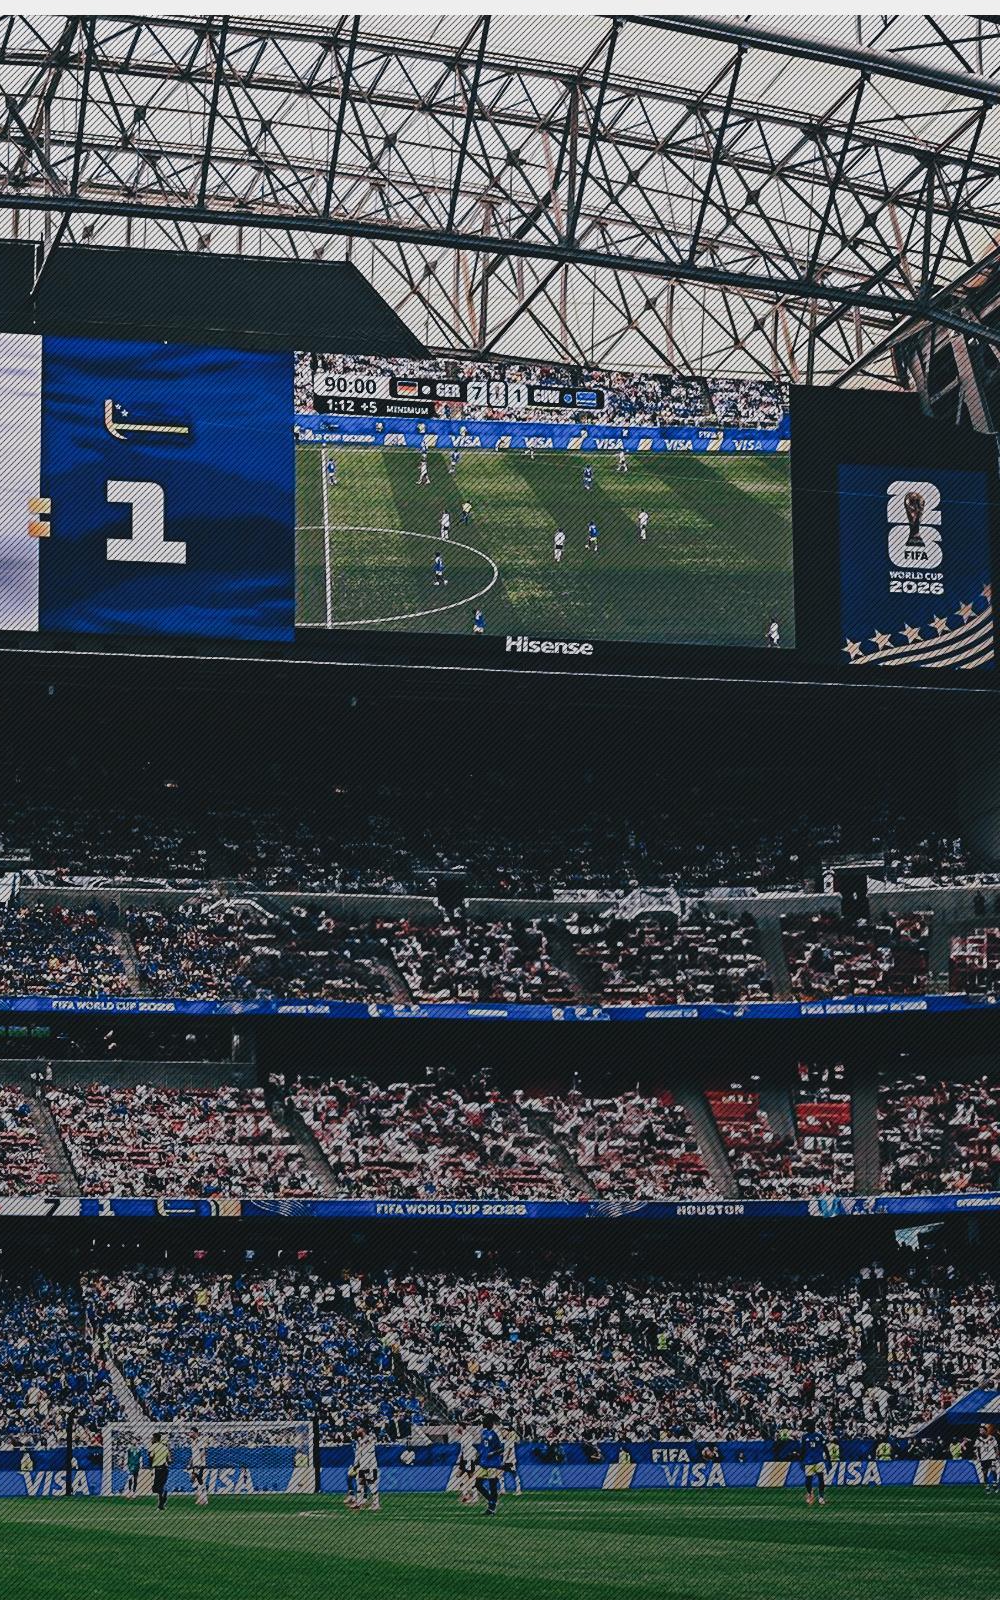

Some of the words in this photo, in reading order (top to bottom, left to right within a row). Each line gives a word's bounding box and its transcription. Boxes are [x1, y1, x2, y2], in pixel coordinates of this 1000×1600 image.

[324, 376, 378, 395] 90:00
[436, 382, 461, 398] GER
[471, 386, 483, 401] 7
[513, 389, 522, 403] 1
[533, 388, 560, 404] CUW
[326, 399, 355, 413] 1:12
[360, 400, 378, 414] +5
[386, 405, 429, 415] MINIMUM
[450, 435, 482, 448] VISA
[698, 430, 717, 440] FIFA
[593, 437, 625, 450] VISA
[664, 438, 694, 451] VISA
[731, 439, 764, 451] VISA
[106, 479, 187, 565] 1
[904, 550, 929, 562] FIFA
[889, 570, 923, 581] WORLD
[924, 572, 944, 581] CUP
[889, 581, 945, 596] 2026
[505, 636, 594, 656] Hisense
[52, 1000, 75, 1011] FIFA
[76, 1001, 115, 1012] WORLD
[116, 1002, 138, 1012] CUP
[138, 1002, 176, 1012] 2026
[44, 1199, 61, 1216] 7
[98, 1199, 115, 1216] 1
[376, 1204, 404, 1215] FIFA
[406, 1204, 452, 1215] WORLD
[454, 1204, 480, 1215] CUP
[482, 1204, 528, 1216] 2026
[676, 1205, 745, 1216] HOUSTON
[651, 1448, 690, 1463] FIFA
[660, 1462, 727, 1487] VISA
[18, 1470, 91, 1496] VISA
